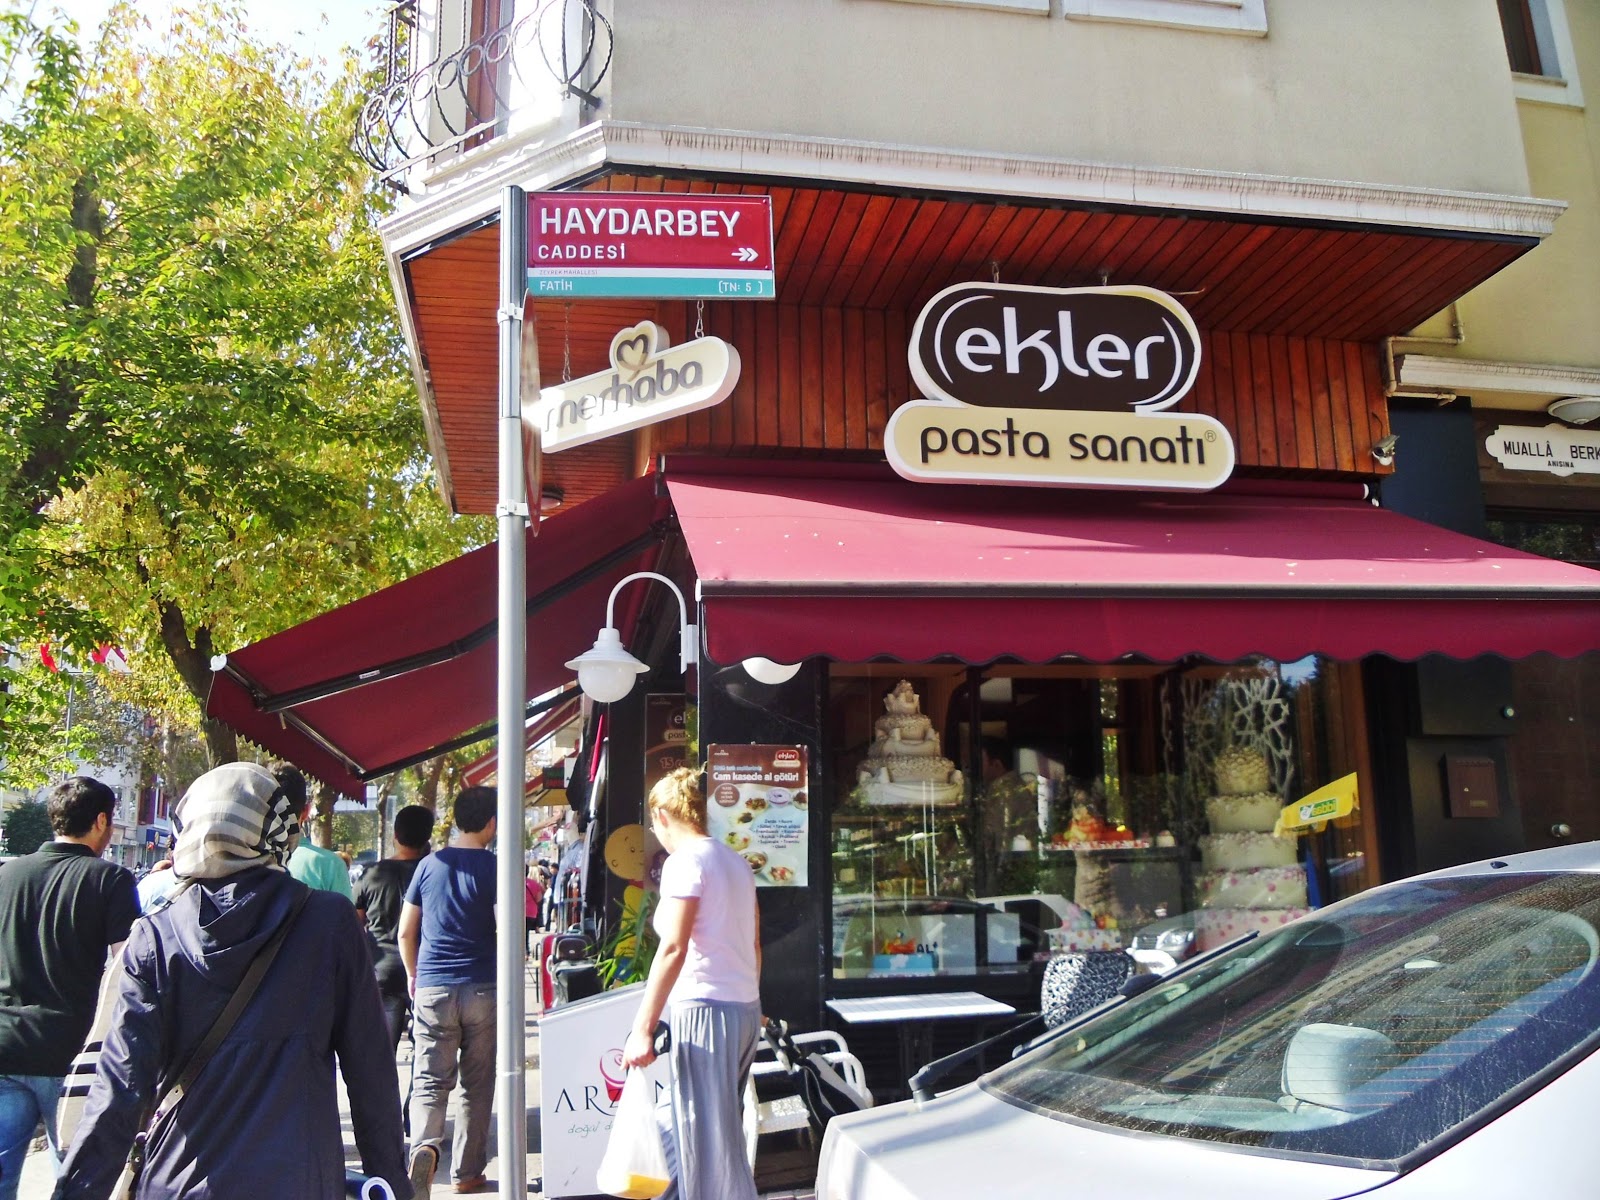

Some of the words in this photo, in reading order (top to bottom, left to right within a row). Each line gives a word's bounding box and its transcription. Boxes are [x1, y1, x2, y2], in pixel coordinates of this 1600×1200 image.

[540, 207, 740, 237] HAYDARBEY
[538, 242, 626, 260] CADDESİ
[540, 278, 573, 291] FATİH
[745, 282, 752, 292] 5
[955, 306, 1165, 392] ekler
[920, 417, 1050, 464] pasta
[713, 772, 731, 781] Cam
[732, 772, 763, 781] kasede
[764, 772, 773, 781] al
